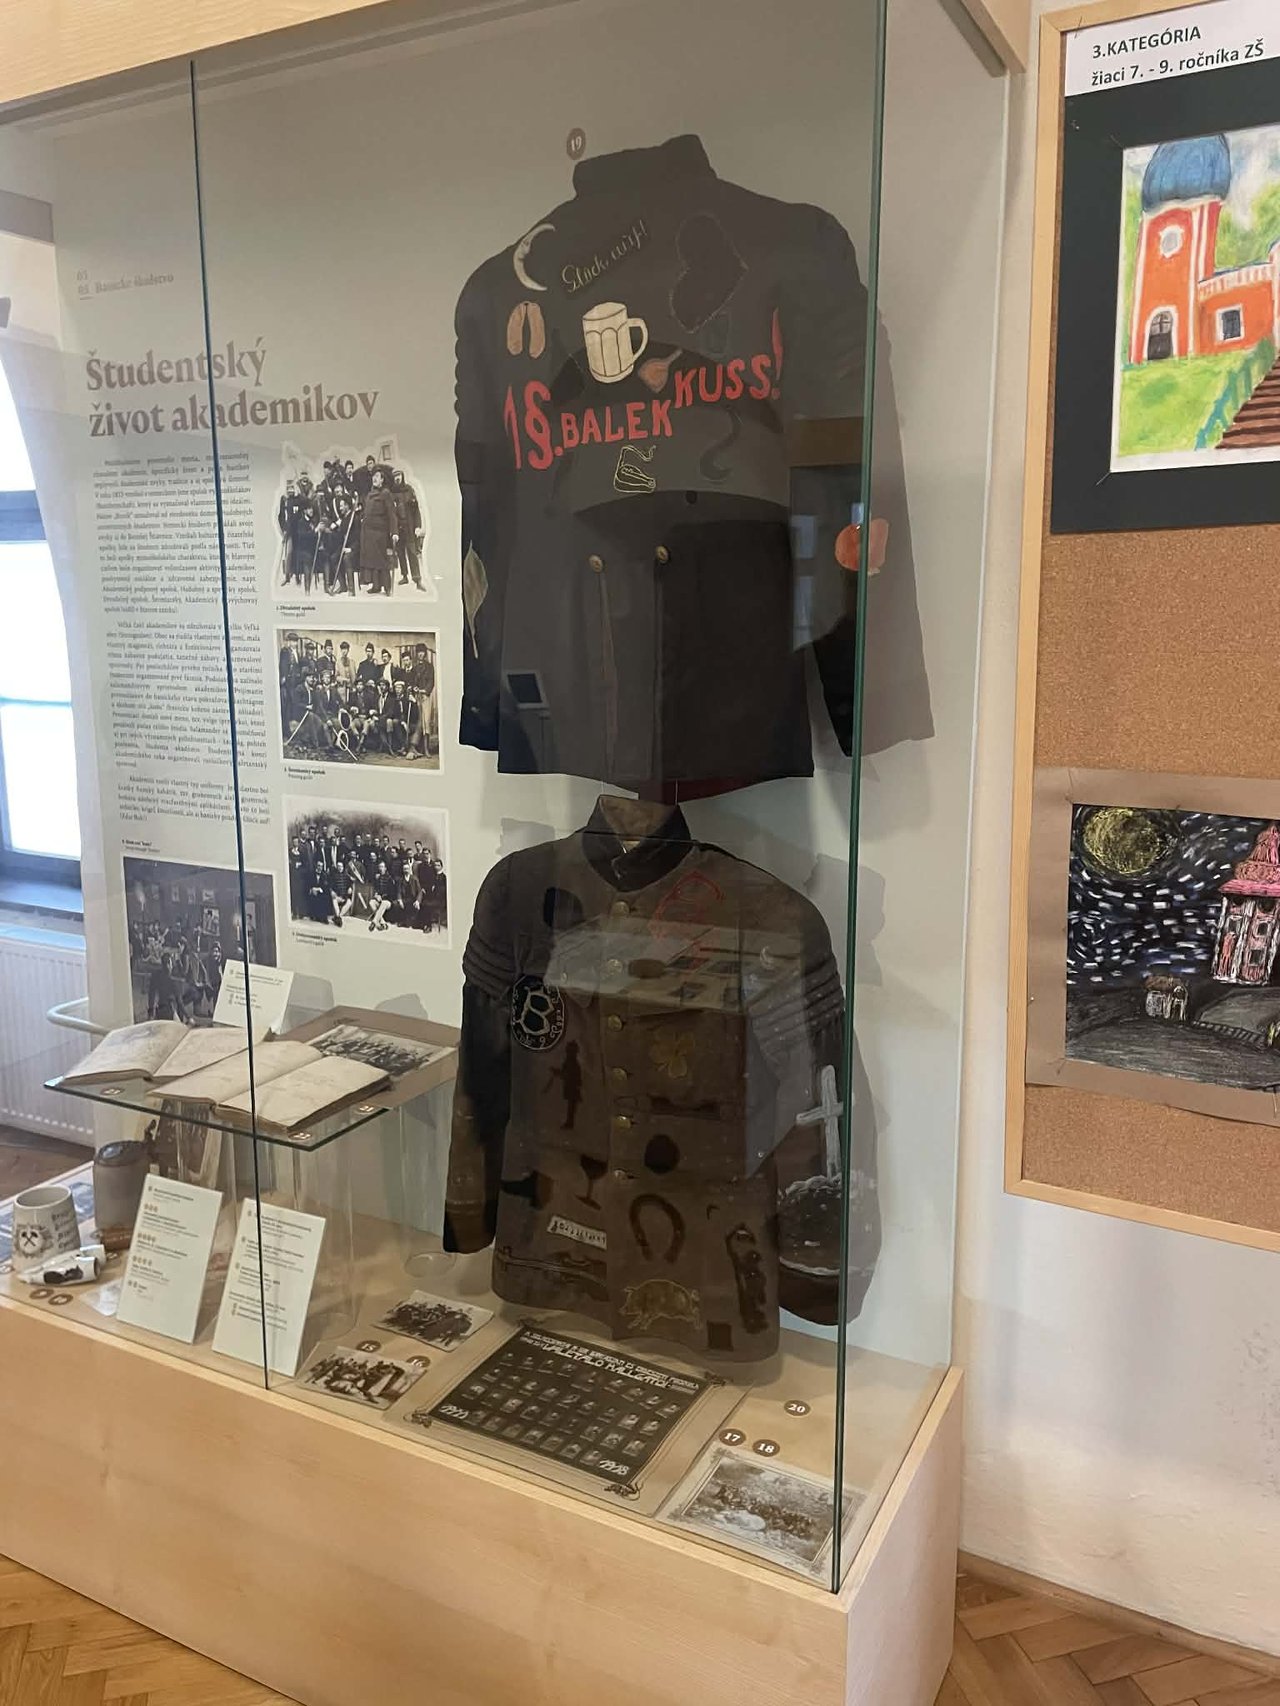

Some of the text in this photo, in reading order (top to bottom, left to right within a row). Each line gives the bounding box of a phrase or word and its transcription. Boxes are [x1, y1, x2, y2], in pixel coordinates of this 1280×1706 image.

[1091, 67, 1125, 86] žiaci
[1130, 65, 1144, 79] 7.
[1159, 60, 1173, 74] 9.
[1179, 49, 1239, 71] ročníka
[1244, 38, 1265, 59] ZŠ
[1092, 26, 1201, 59] 3.KATEGÓRIA
[86, 335, 267, 392] Študentský
[561, 400, 673, 449] BALEK
[674, 306, 784, 408] KUSS!
[88, 382, 379, 437] život akademikov
[788, 1403, 806, 1413] 20
[724, 1432, 741, 1442] 17
[757, 1443, 775, 1454] 18
